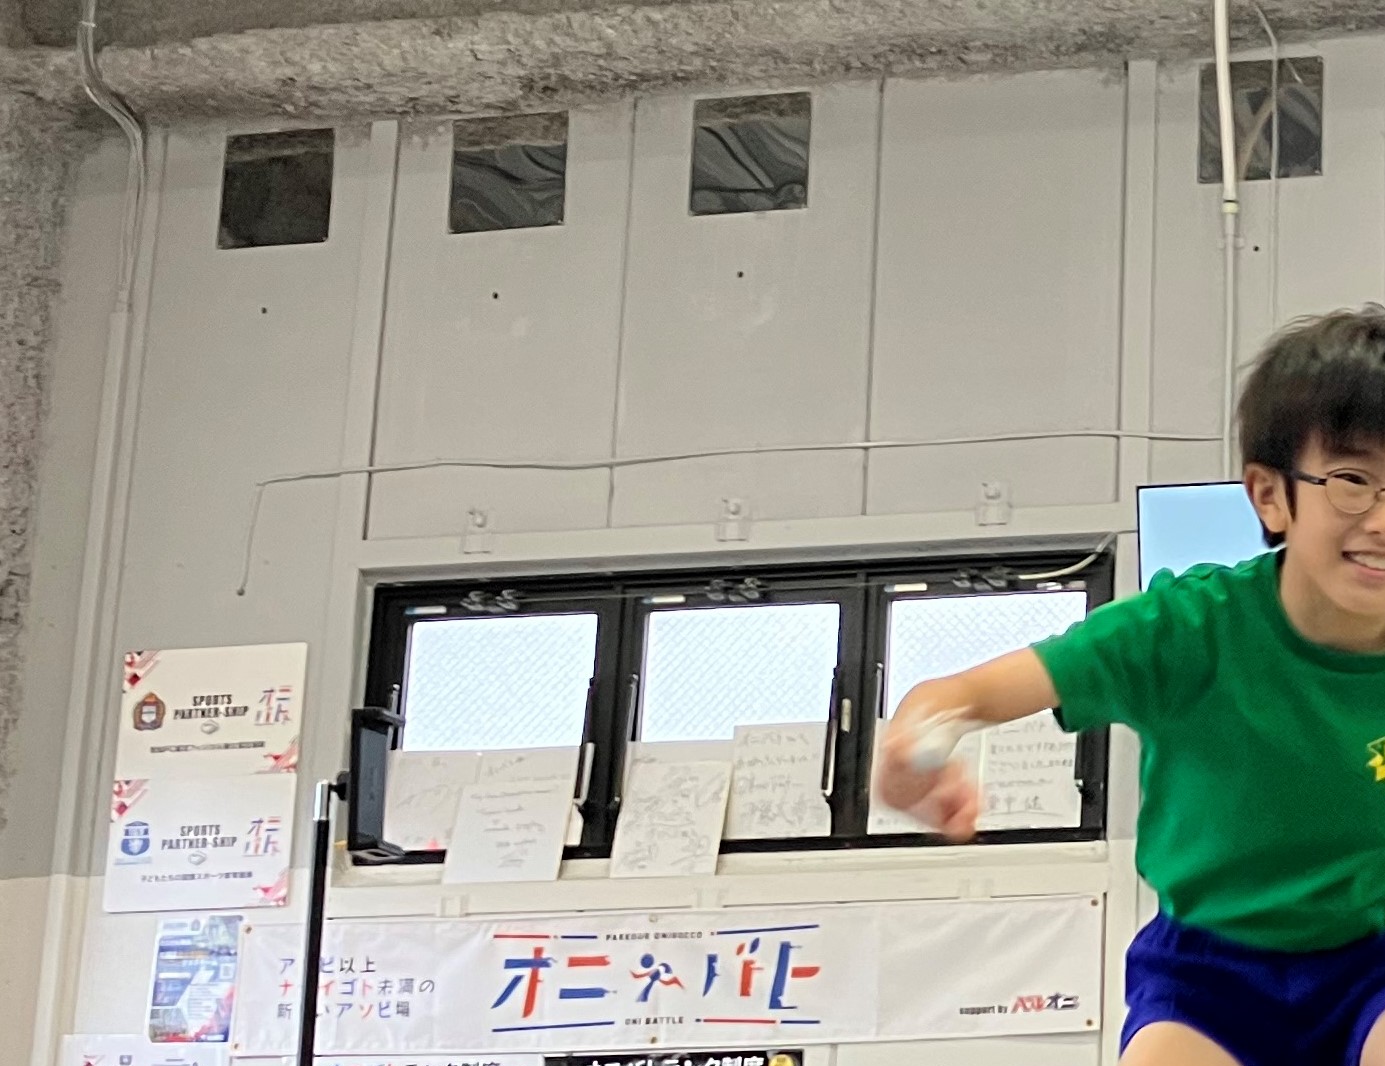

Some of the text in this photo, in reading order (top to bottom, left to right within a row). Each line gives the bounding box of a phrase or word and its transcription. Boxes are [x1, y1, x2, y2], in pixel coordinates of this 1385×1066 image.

[180, 825, 220, 837] SPORTS
[279, 957, 377, 974] アビ以上
